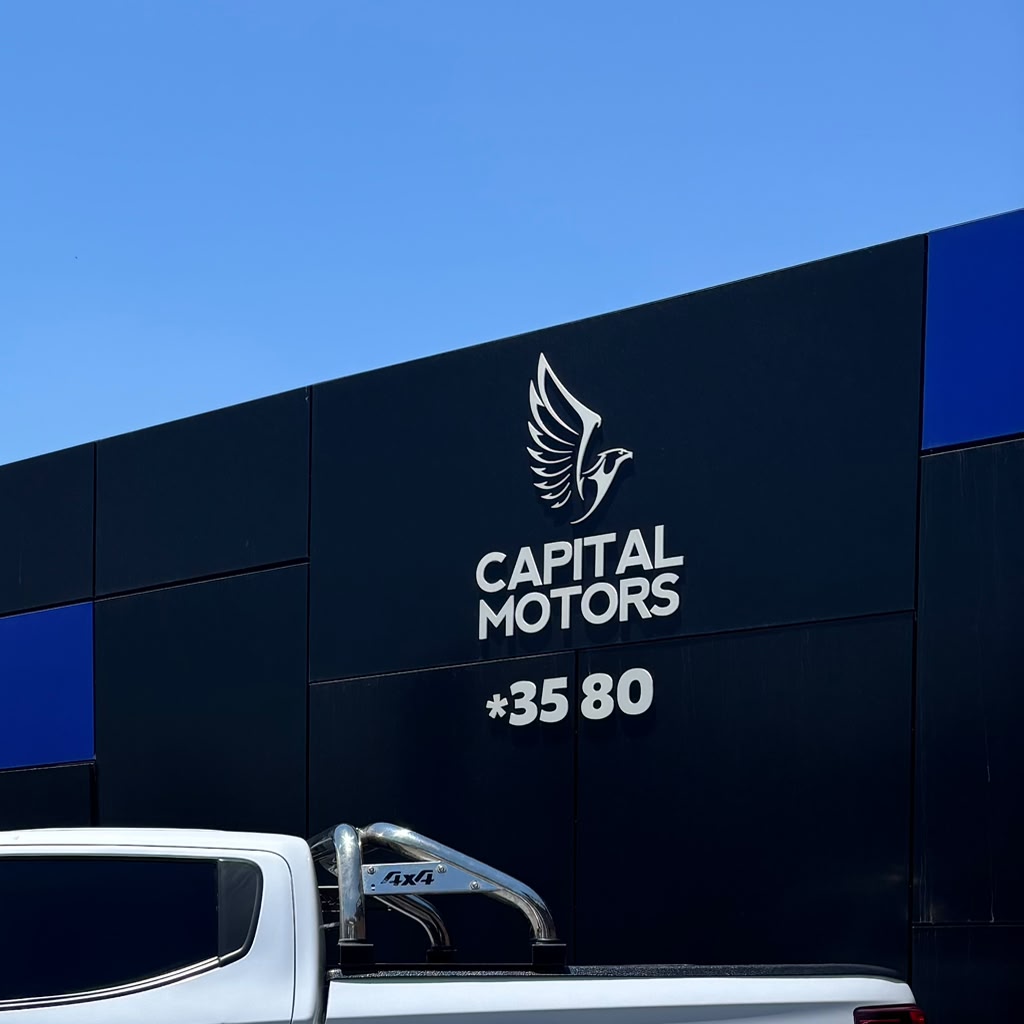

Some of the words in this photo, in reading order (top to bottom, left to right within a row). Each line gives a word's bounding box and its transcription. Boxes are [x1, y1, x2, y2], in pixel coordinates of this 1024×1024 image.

[475, 525, 685, 593] CAPITAL
[478, 572, 680, 641] MOTORS
[380, 869, 435, 887] 4x4
